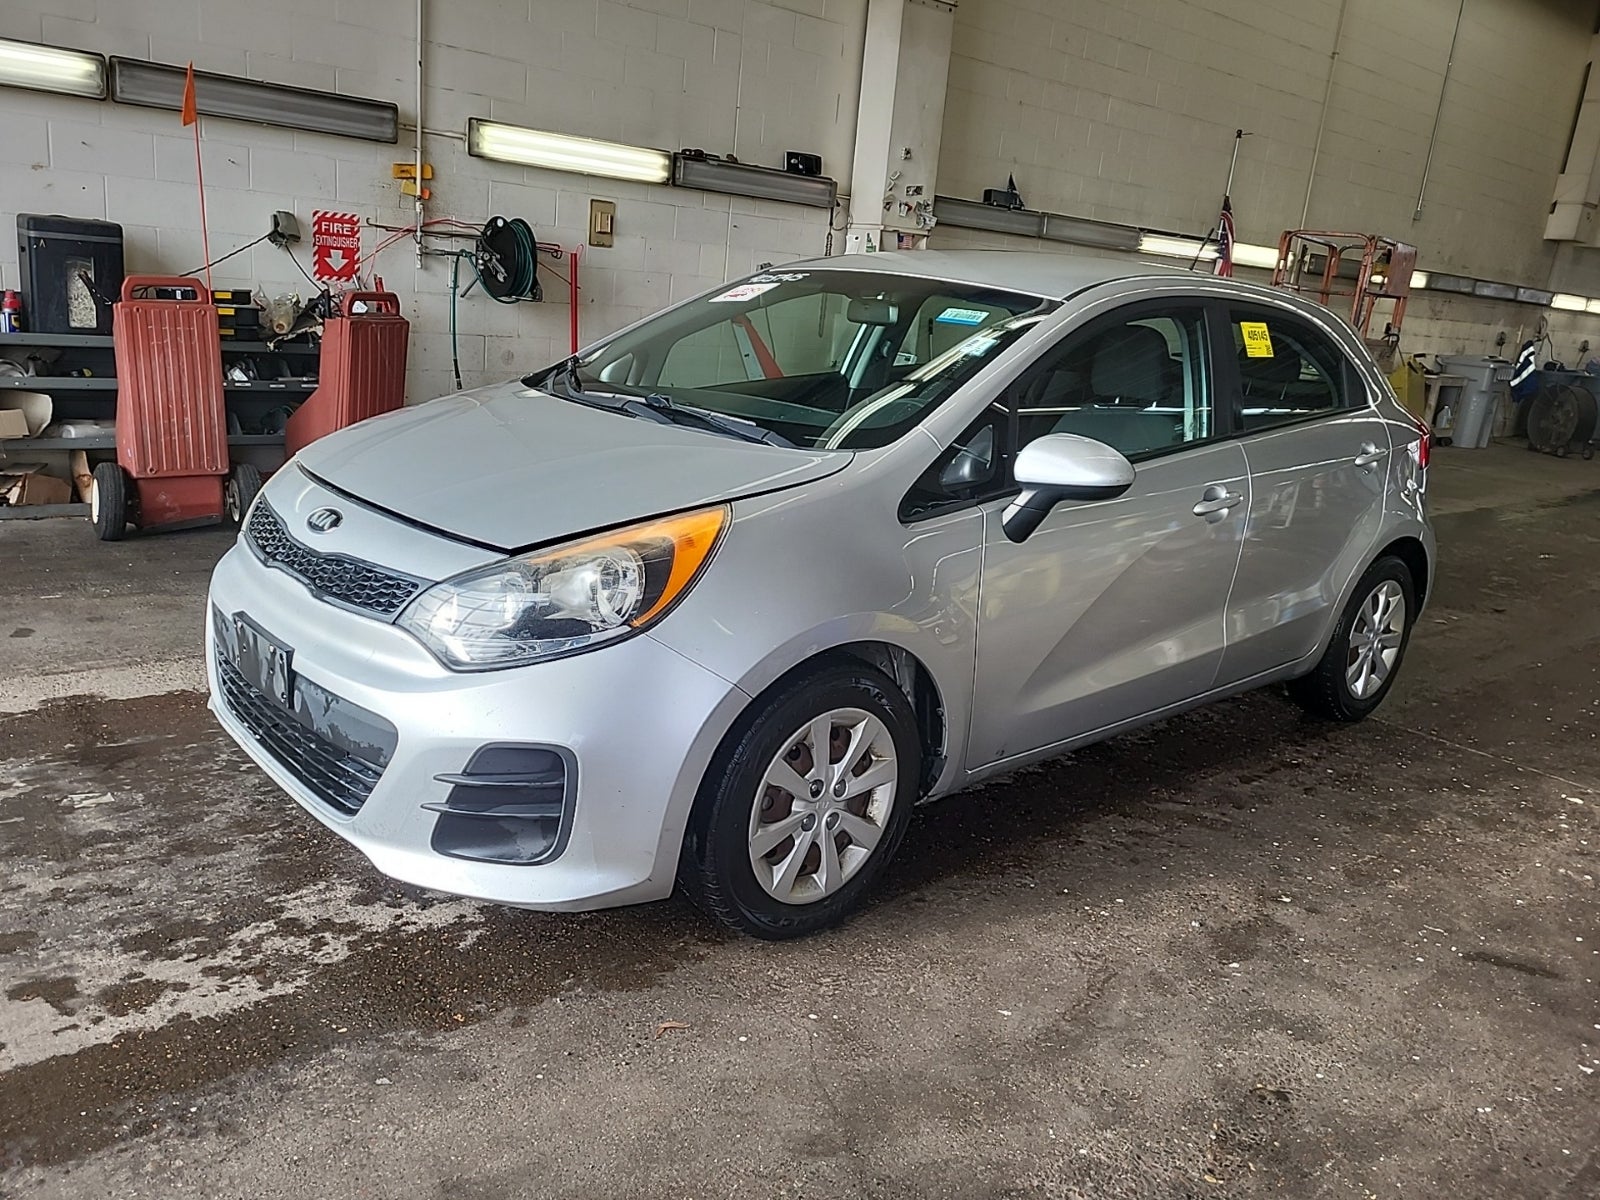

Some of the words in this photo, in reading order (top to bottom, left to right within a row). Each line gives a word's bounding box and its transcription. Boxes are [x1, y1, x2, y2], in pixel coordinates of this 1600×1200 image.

[321, 221, 352, 235] FIRE
[315, 234, 358, 249] EXTINGUISHER
[1247, 329, 1269, 342] 405145
[309, 509, 338, 531] KIA
